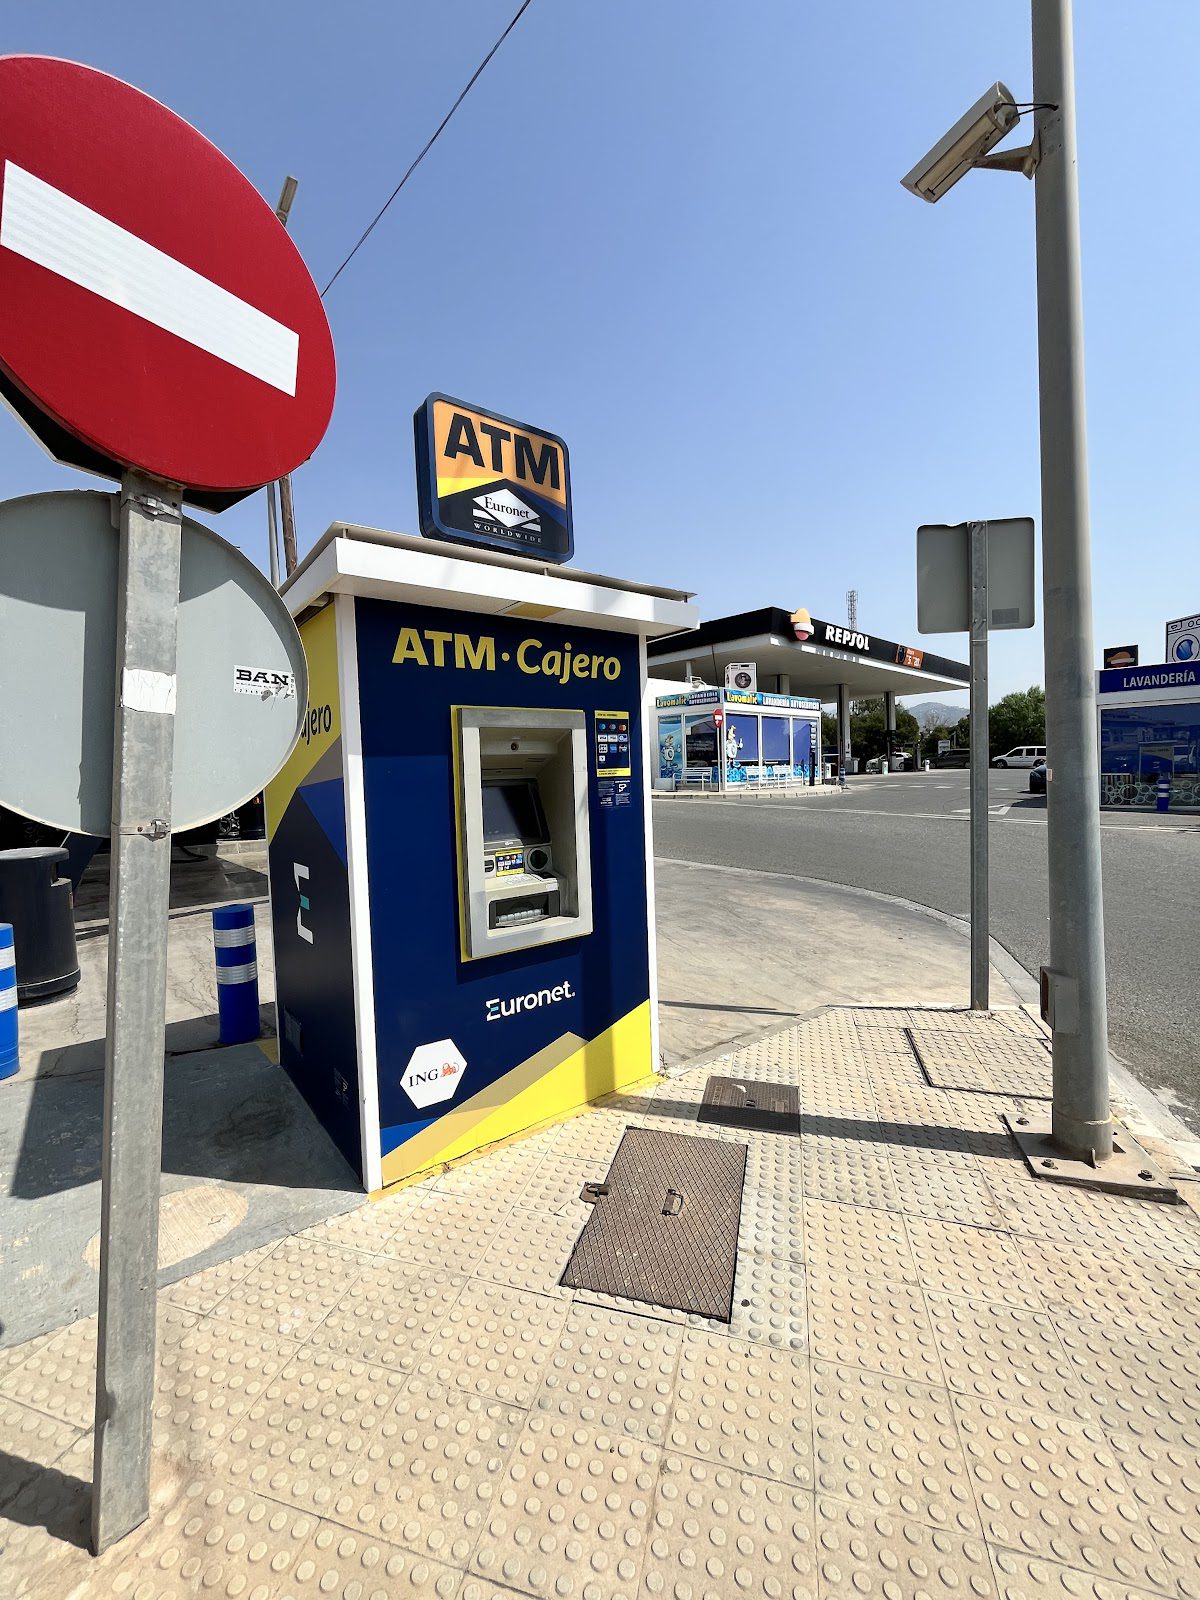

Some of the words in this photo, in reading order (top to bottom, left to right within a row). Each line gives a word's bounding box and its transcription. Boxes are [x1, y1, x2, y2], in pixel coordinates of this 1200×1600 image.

[444, 412, 561, 491] ATM
[484, 496, 530, 519] Euronet
[473, 522, 542, 543] WORLDWIDE
[825, 624, 870, 651] REPSOL
[236, 669, 289, 686] BAN
[1123, 670, 1196, 688] LAVANDERÍA
[656, 695, 687, 708] Lavomatic
[726, 691, 758, 705] Lavomatic
[301, 700, 332, 746] jero
[408, 1068, 439, 1088] ING
